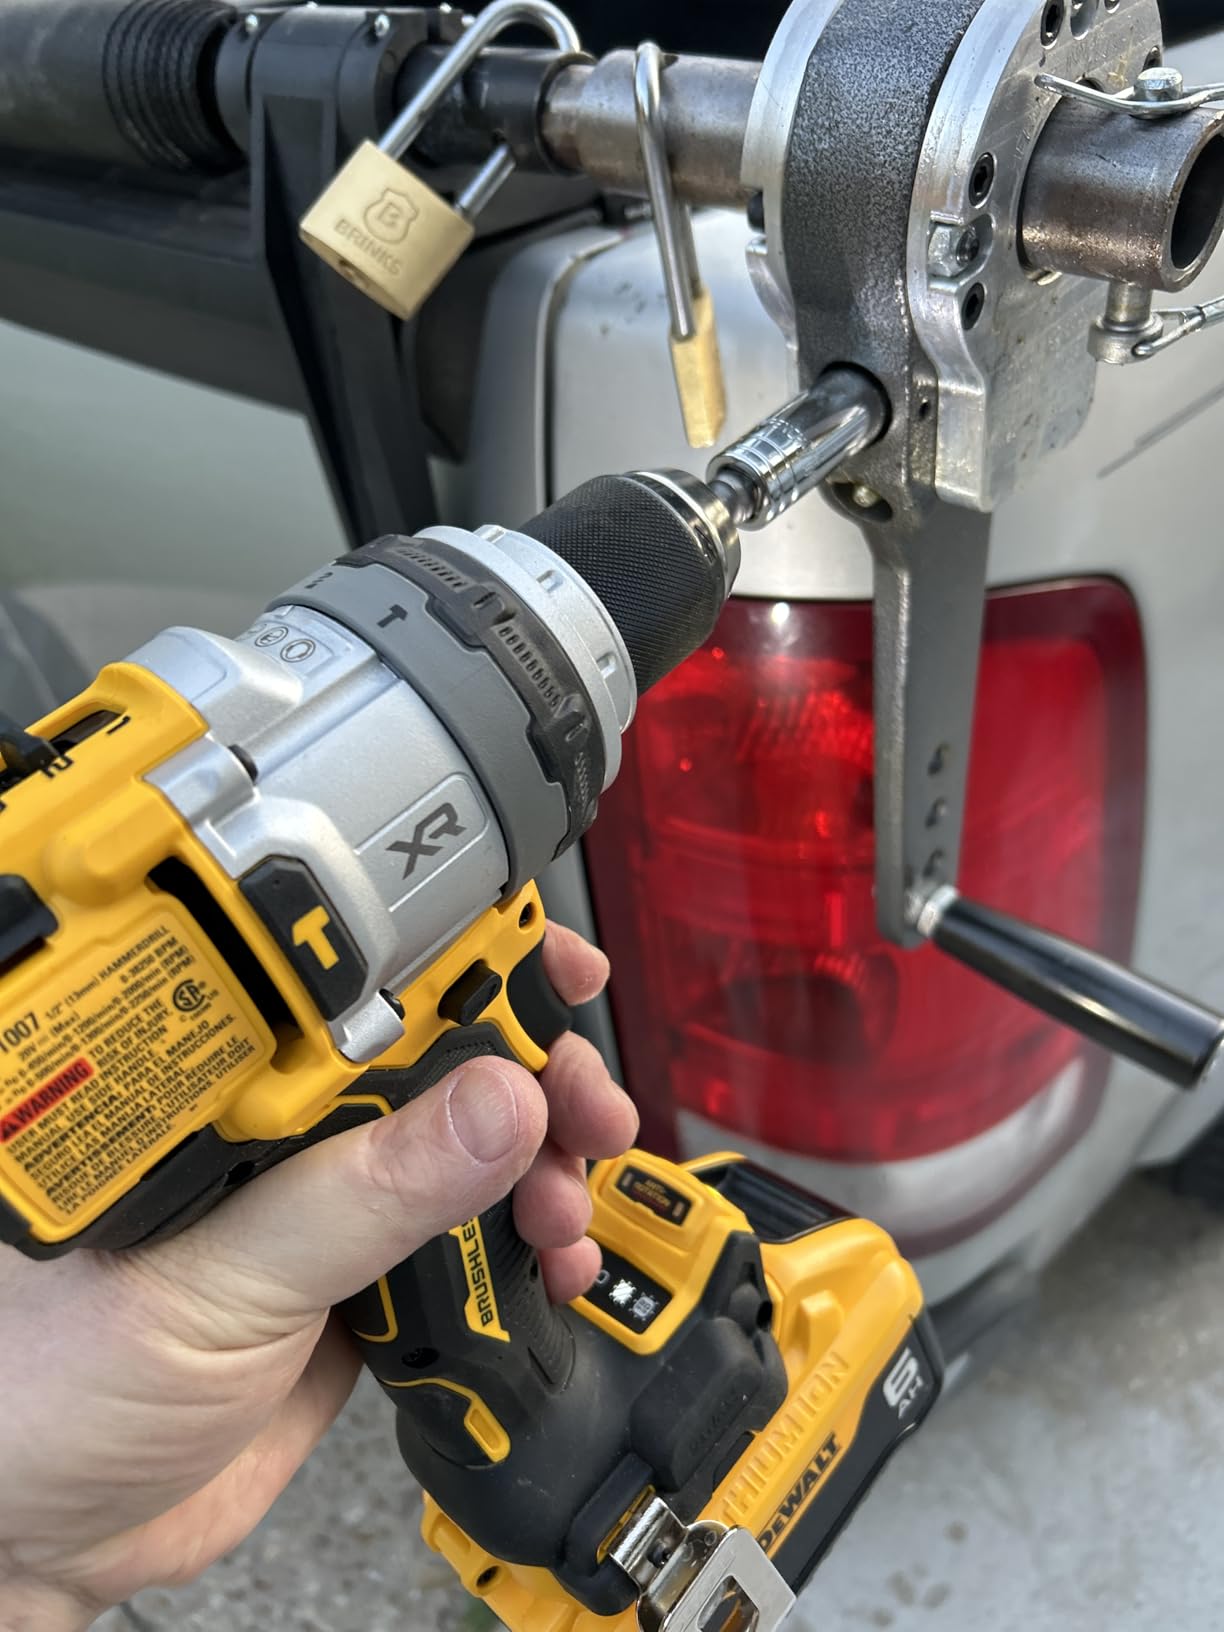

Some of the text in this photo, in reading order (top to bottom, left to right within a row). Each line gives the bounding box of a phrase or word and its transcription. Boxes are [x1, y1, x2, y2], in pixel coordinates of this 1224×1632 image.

[333, 218, 402, 275] BRINKS
[384, 802, 468, 881] XR
[98, 924, 168, 980] HAMMERDRILL
[153, 936, 179, 958] BPM
[159, 943, 189, 970] (RPM)
[166, 953, 197, 980] (RPM)
[89, 998, 162, 1058] TO REDUCE THE
[96, 1046, 120, 1068] RISK
[119, 1035, 133, 1049] OF
[7, 1025, 168, 1154] USER MUST READ INSTRUCTION
[12, 1060, 88, 1124] WARNING
[23, 1019, 209, 1171] ADVERTENCIA: PARA EL MANEJO
[44, 1103, 156, 1196] AVERTISSEMENT:
[155, 1079, 185, 1105] POUR
[225, 1035, 239, 1048] LE
[50, 1170, 89, 1203] RISQUE
[90, 1155, 106, 1171] DE
[227, 1037, 251, 1058] DOIT
[64, 1102, 87, 1122] USE
[87, 1081, 114, 1105] SIDE
[29, 1144, 72, 1181] SEGURO
[71, 1128, 92, 1147] LEA
[90, 1118, 104, 1132] EL
[103, 1083, 147, 1121] MANUAL
[145, 1071, 161, 1087] DE
[37, 1153, 78, 1189] UTILICE
[78, 1135, 101, 1156] LAS
[99, 1099, 144, 1138] MANIJA
[56, 1190, 78, 1210] LIRE
[78, 1180, 91, 1192] LE
[93, 1145, 134, 1181] MANUEL
[215, 1045, 255, 1080] UTILISER
[66, 1200, 80, 1214] LA
[460, 1218, 494, 1327] BRUSHLE
[882, 1347, 920, 1408] 6
[897, 1371, 925, 1420] AH
[757, 1432, 841, 1553] DEWALT
